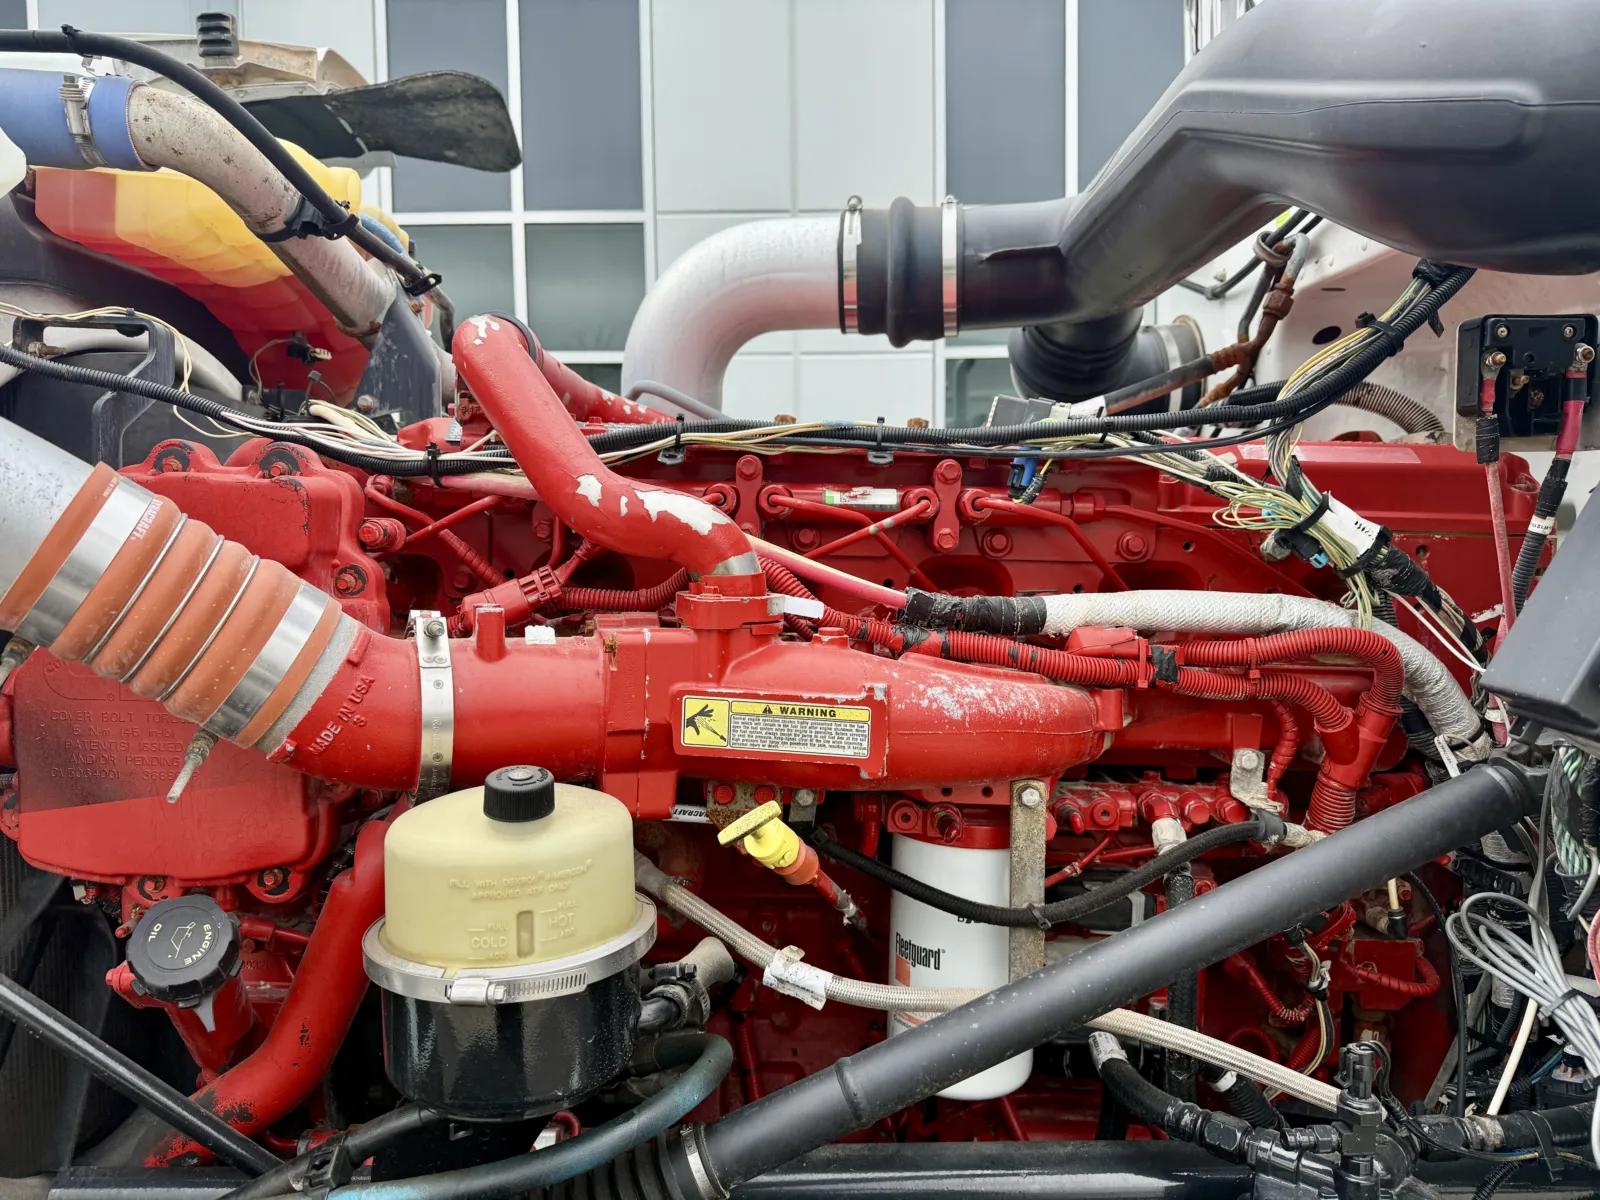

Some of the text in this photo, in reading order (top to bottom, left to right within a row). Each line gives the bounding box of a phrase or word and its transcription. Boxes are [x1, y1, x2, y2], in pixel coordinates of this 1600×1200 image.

[308, 674, 375, 753] MADE IN USA
[780, 707, 836, 717] WARNING
[125, 754, 181, 766] PENDING
[548, 912, 575, 928] HOT
[148, 923, 162, 943] OIL
[184, 924, 213, 966] ENGINE
[472, 936, 508, 949] COLD
